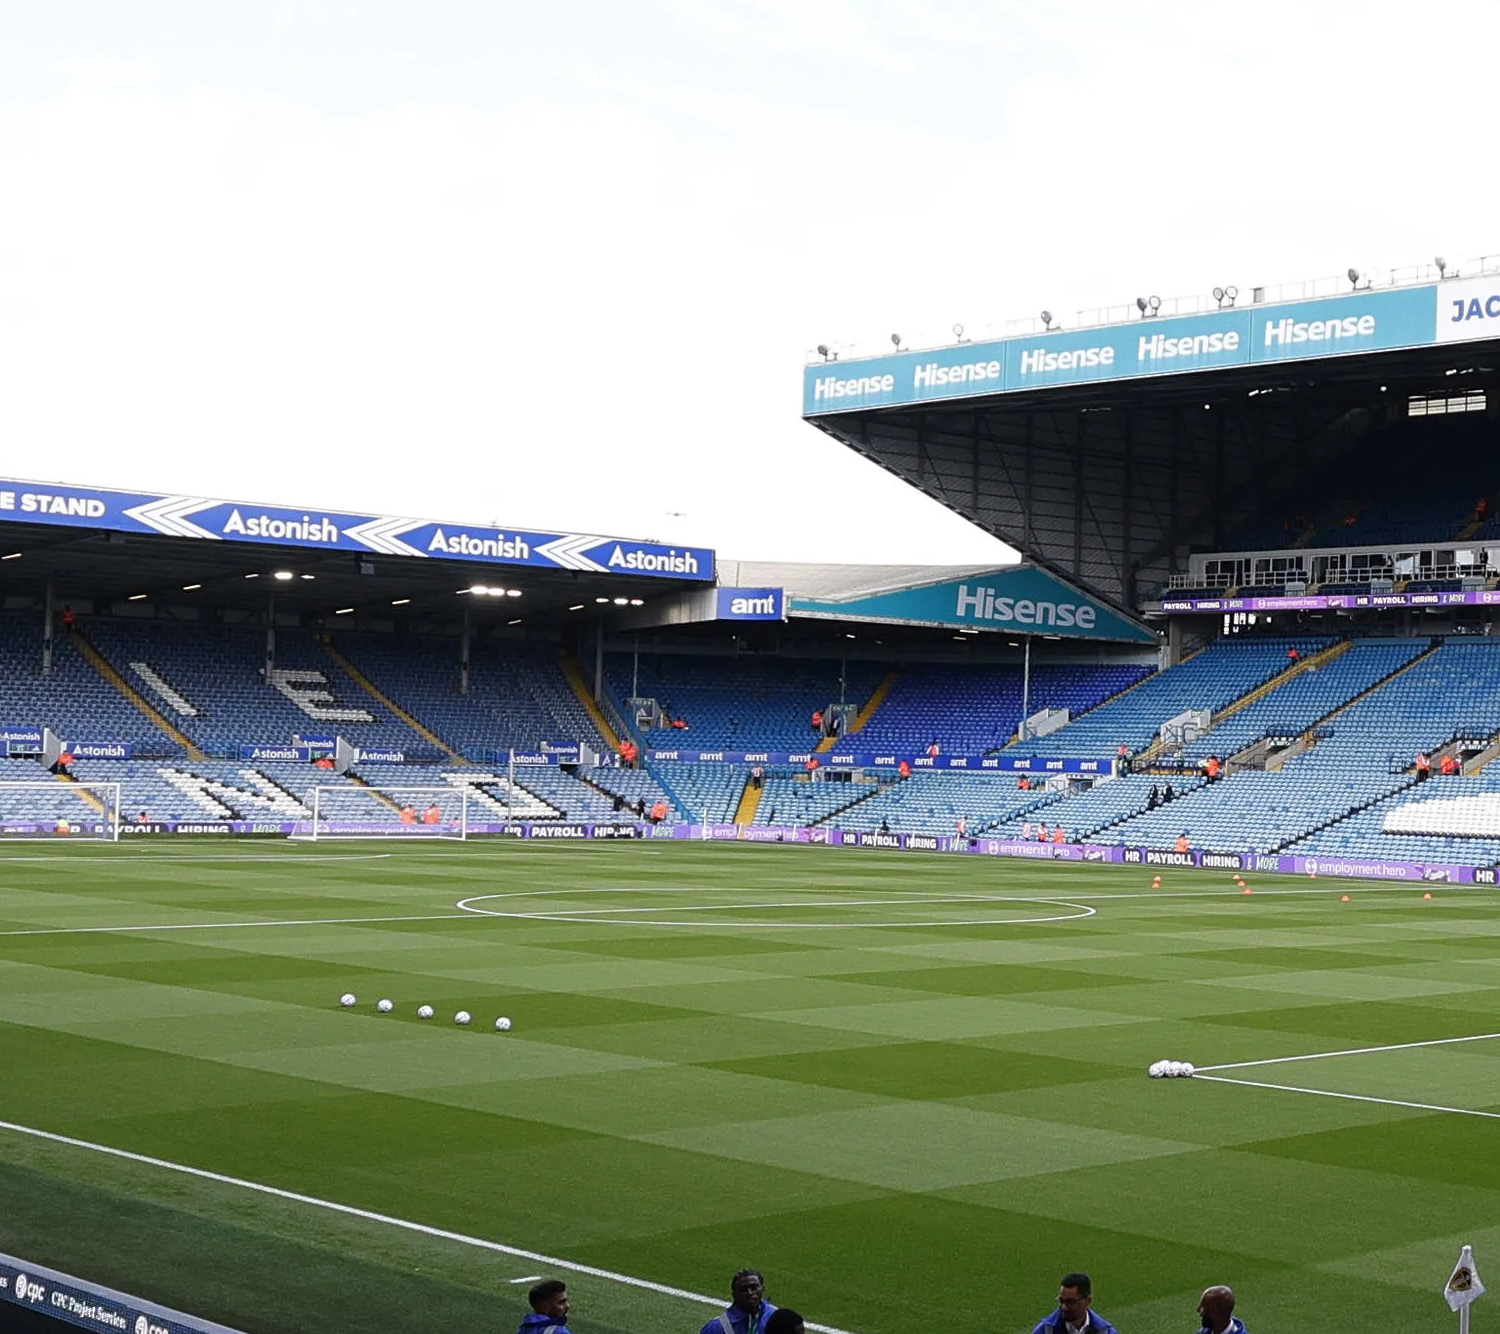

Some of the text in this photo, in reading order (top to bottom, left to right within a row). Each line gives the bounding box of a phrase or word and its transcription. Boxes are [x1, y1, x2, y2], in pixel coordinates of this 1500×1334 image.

[1264, 312, 1375, 346] Hisense
[1138, 329, 1239, 361] Hisense
[1020, 345, 1115, 374] Hisense
[914, 359, 1000, 387] Hisense
[814, 372, 894, 399] Hisense
[21, 493, 105, 518] STAND
[222, 509, 337, 543] Astonish
[428, 527, 528, 560] Astonish
[608, 545, 697, 573] Astonish
[731, 594, 774, 615] amt
[956, 585, 1096, 628] Hisense
[2, 731, 40, 741] Astonish
[73, 745, 125, 757] Astonish
[251, 749, 299, 760] Astonish
[360, 751, 404, 763] Astonish
[655, 750, 678, 760] amt
[700, 751, 724, 761] amt
[789, 754, 811, 763] amt
[832, 755, 853, 764] amt
[915, 757, 933, 765] amt
[950, 758, 967, 766] amt
[982, 759, 998, 767] amt
[1046, 760, 1063, 769] amt
[1080, 761, 1097, 770] amt
[532, 826, 584, 838] PAYROLL
[1125, 851, 1279, 870] HR PAYROLL HIRING & MORE
[1320, 863, 1406, 876] employment hero
[1476, 871, 1494, 883] HR
